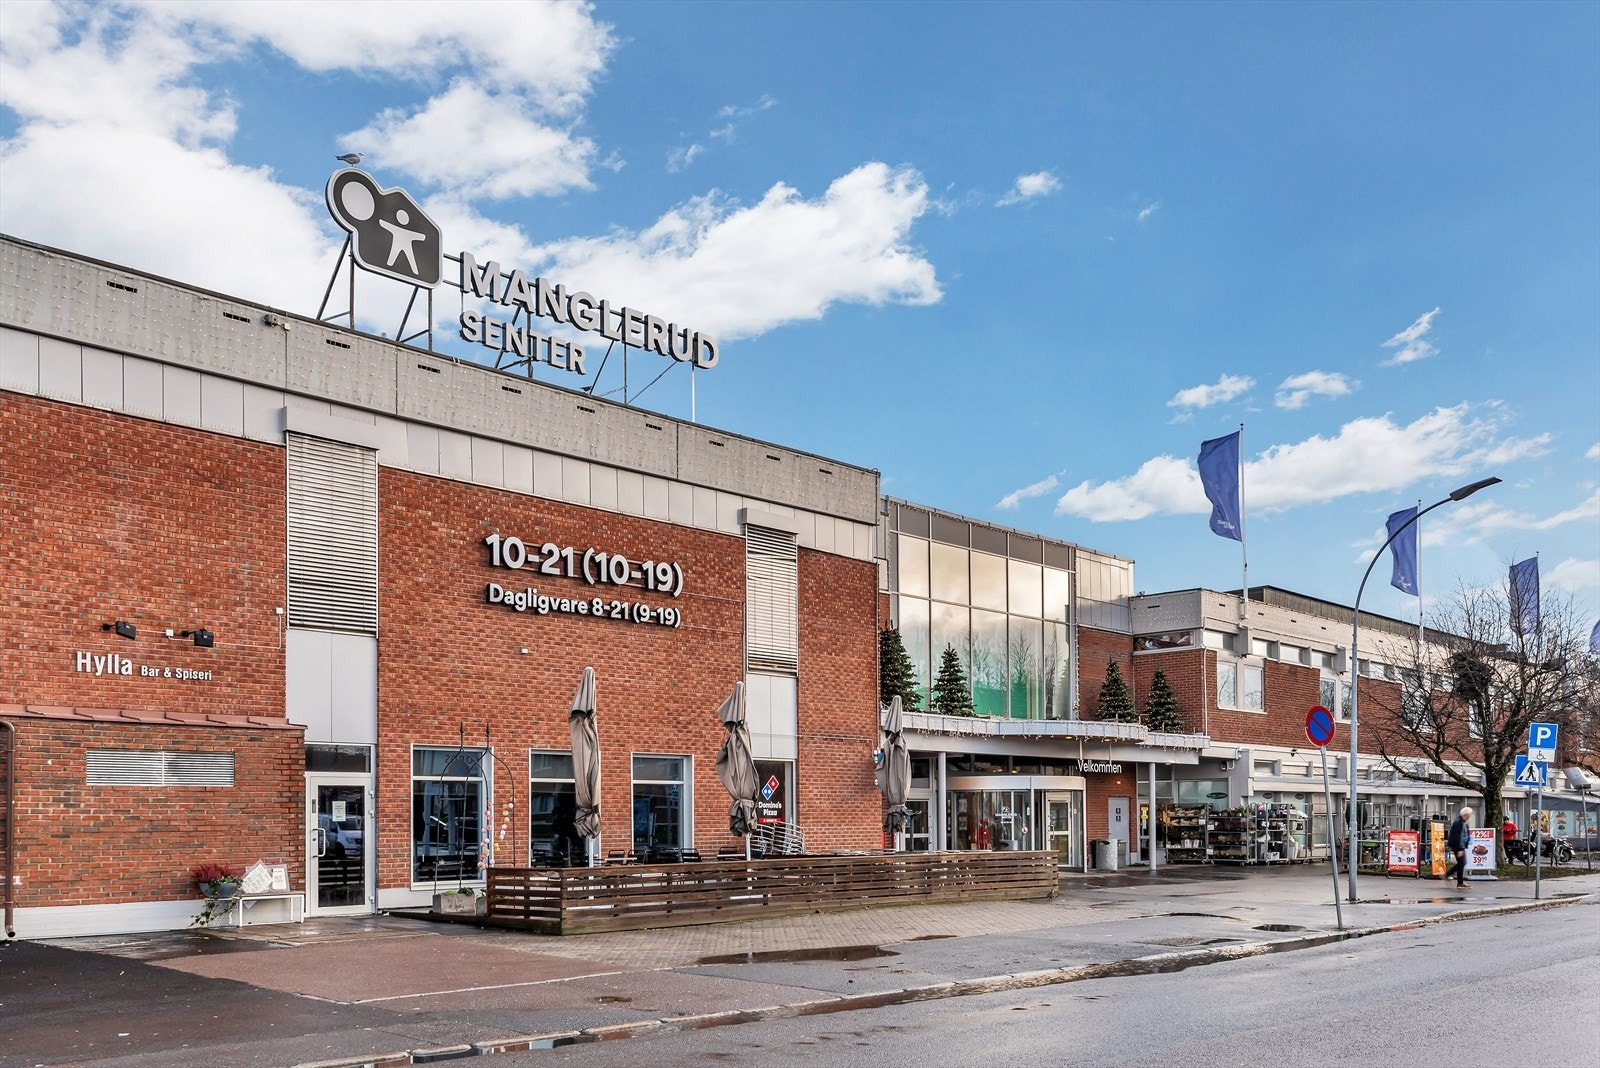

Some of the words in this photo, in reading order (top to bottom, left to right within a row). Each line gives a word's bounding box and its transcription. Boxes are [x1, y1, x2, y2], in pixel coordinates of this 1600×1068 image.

[460, 251, 719, 369] MANGLERUD
[459, 310, 586, 375] SENTER
[485, 533, 574, 577] 10-21
[582, 547, 684, 598] (10-19)
[488, 583, 588, 615] Dagligvare
[592, 597, 629, 620] 8-21
[633, 602, 681, 629] (9-19)
[76, 651, 133, 677] Hylla
[141, 665, 160, 677] Bar
[163, 667, 172, 678] &
[175, 668, 212, 681] Spiseri
[1536, 726, 1552, 746] P
[1077, 759, 1122, 773] Velkommen
[763, 808, 778, 816] Pizza
